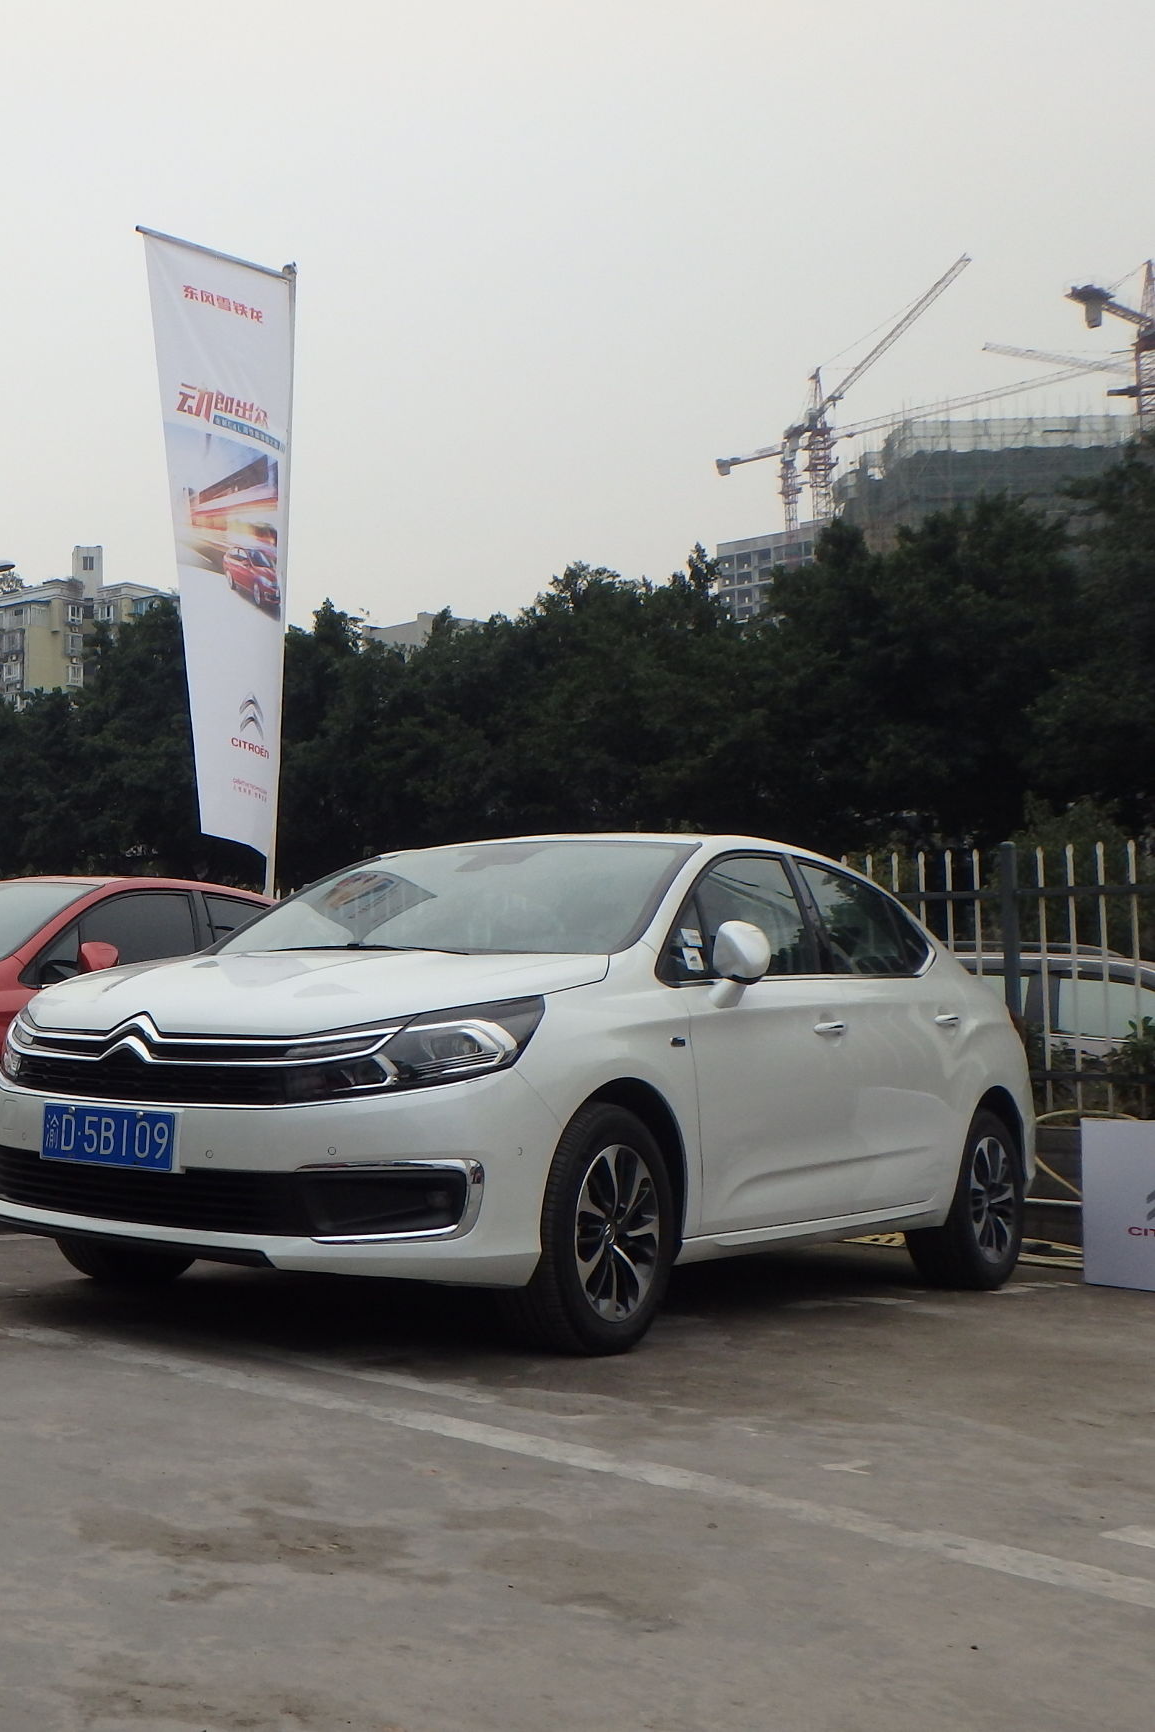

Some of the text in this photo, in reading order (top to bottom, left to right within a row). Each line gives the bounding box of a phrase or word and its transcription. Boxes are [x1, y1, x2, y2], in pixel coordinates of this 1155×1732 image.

[183, 284, 263, 324] 东风雪铁龙
[176, 383, 269, 429] 动即出众
